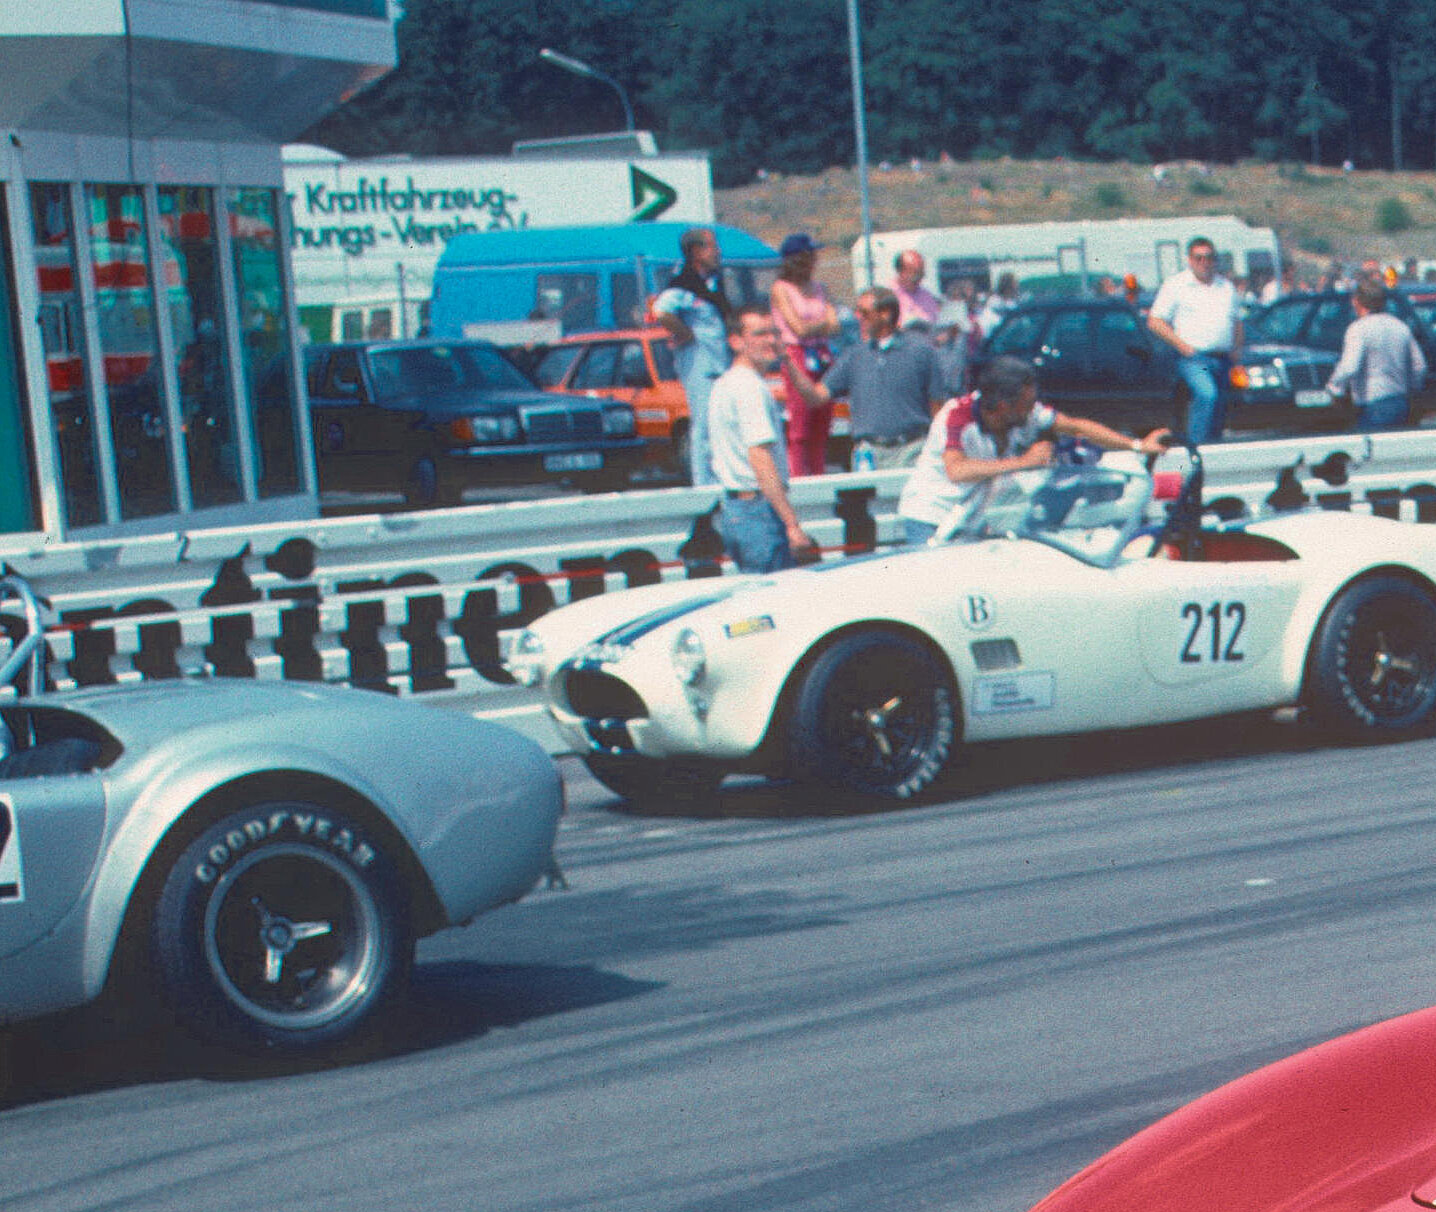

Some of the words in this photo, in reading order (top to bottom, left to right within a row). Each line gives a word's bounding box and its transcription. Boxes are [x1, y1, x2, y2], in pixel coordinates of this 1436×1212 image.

[305, 176, 518, 227] Kraftfahrzeug-
[967, 594, 989, 624] B
[1180, 602, 1246, 662] 212
[196, 810, 376, 884] GOODYEAR
